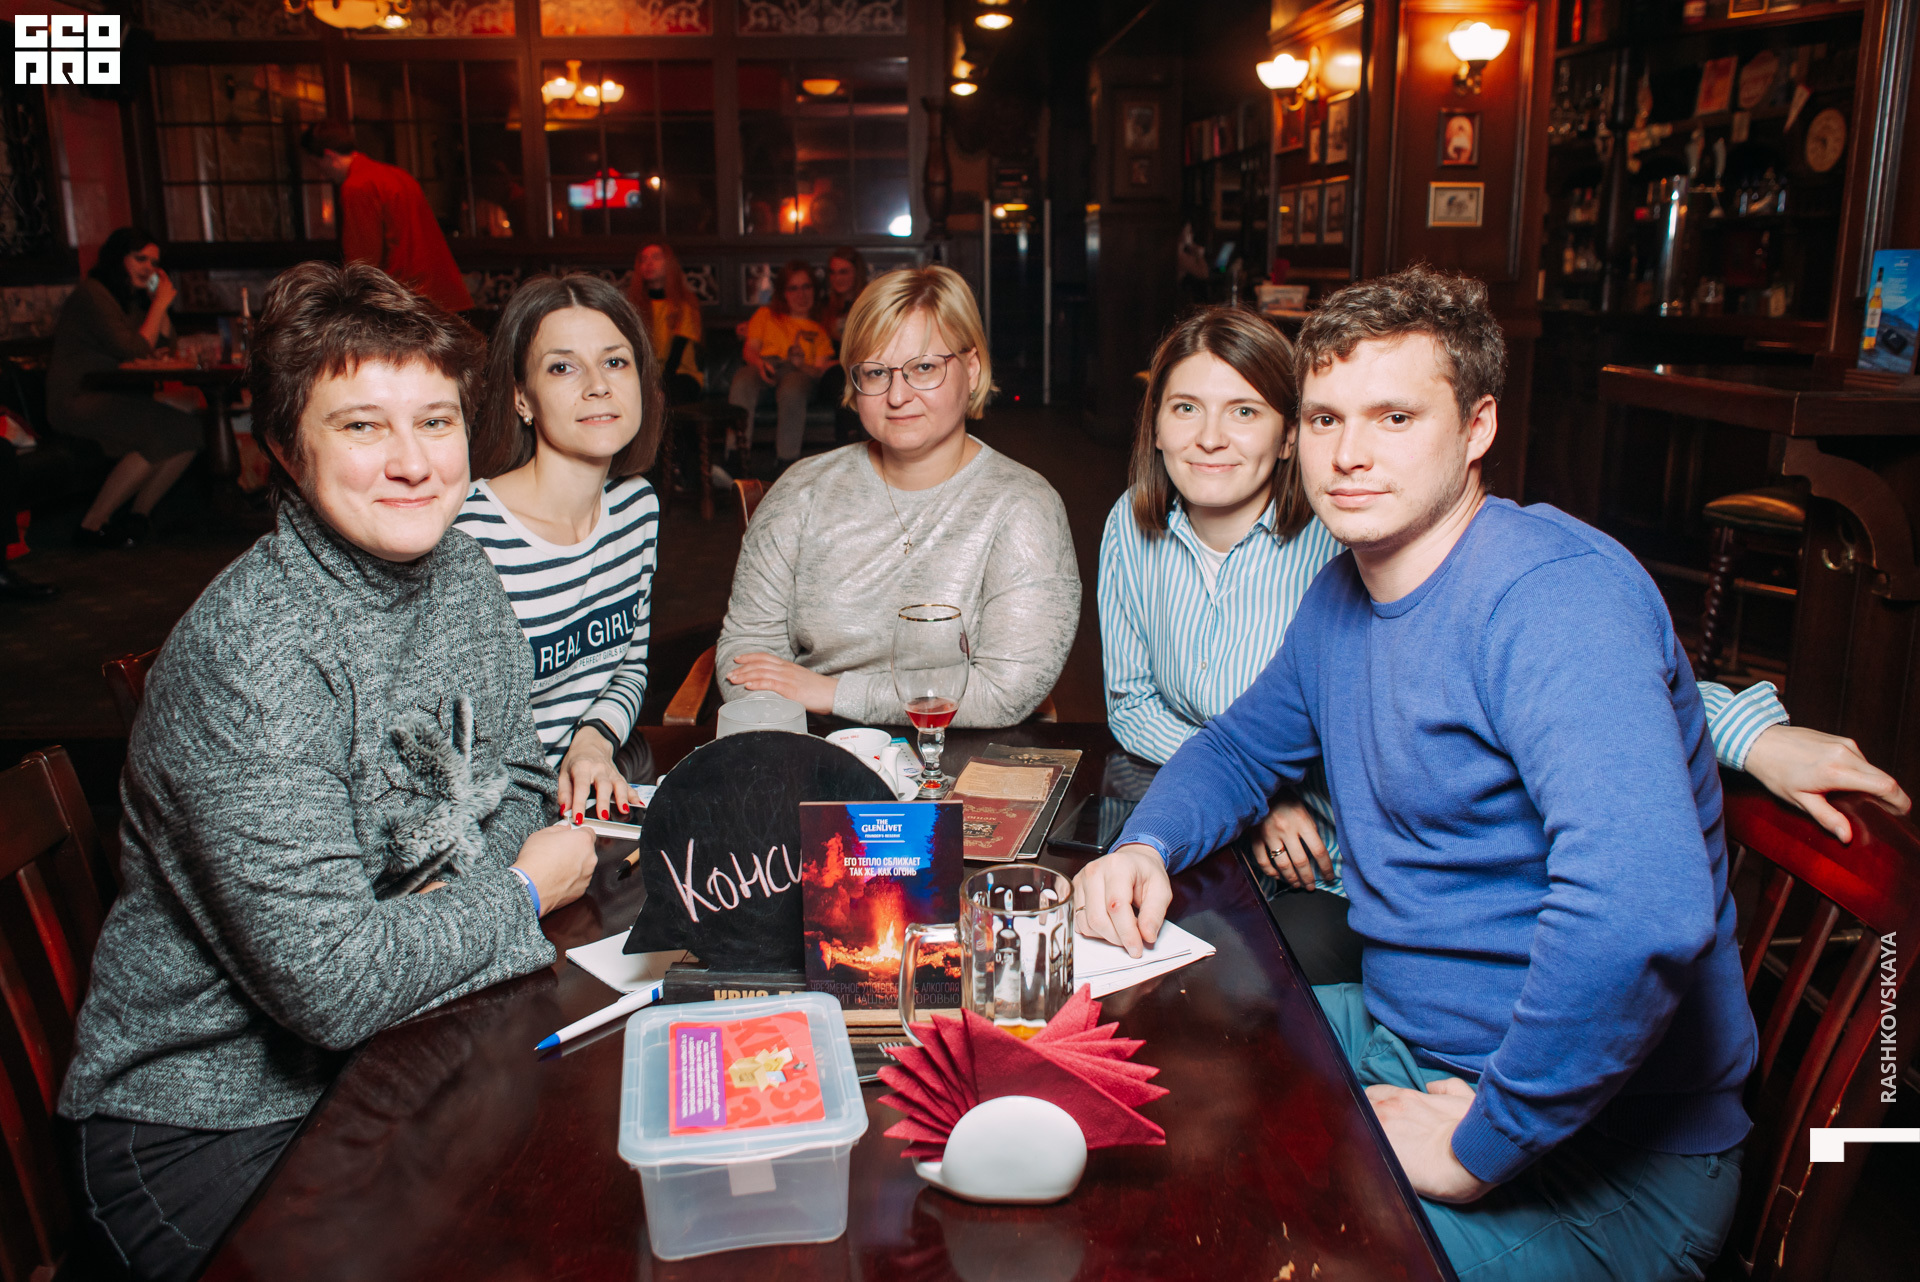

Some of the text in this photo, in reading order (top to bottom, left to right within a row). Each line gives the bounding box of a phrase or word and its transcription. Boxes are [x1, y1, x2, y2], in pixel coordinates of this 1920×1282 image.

[540, 630, 581, 673] REAL
[861, 824, 902, 833] GLENLIVET
[844, 857, 921, 866] ЕГО ТЕПЛО СБЛИЖАЕТ
[849, 867, 863, 876] ТАК
[878, 867, 892, 876] КАК
[893, 867, 917, 876] ОГОНЬ
[810, 982, 859, 993] ЧРЕЗМЕРНОЕ
[921, 982, 960, 993] АЛКОГОЛЯ
